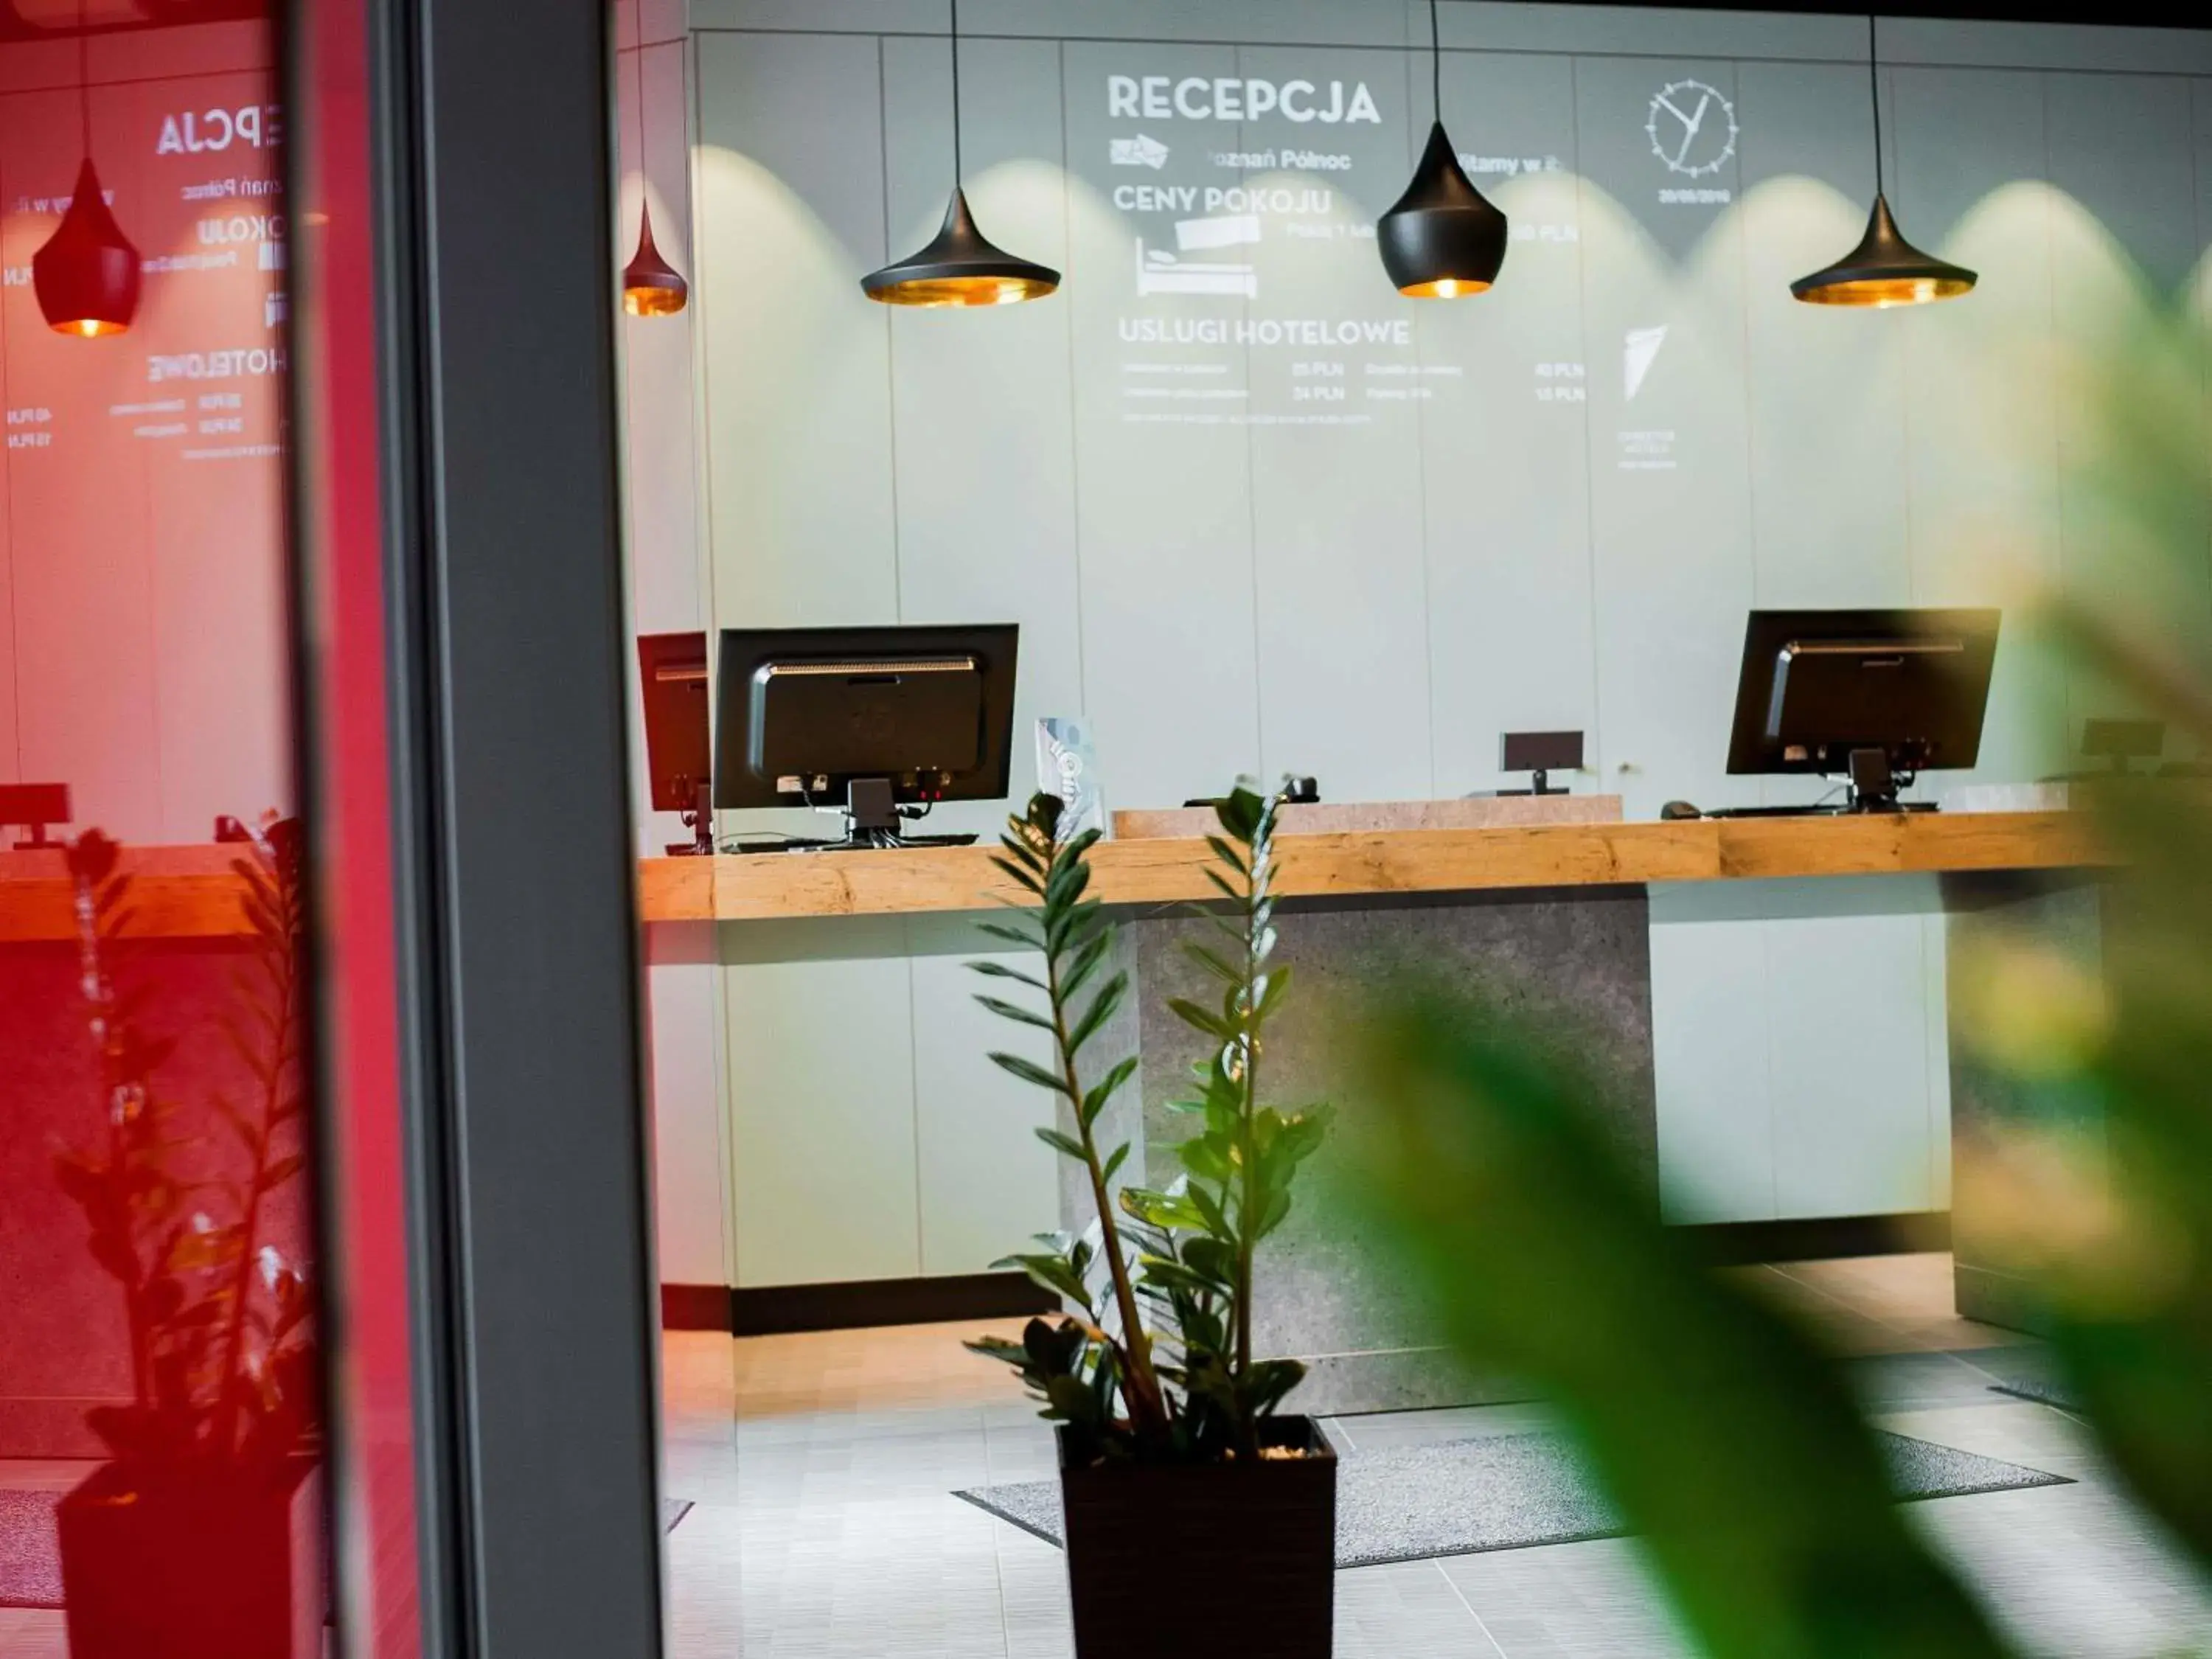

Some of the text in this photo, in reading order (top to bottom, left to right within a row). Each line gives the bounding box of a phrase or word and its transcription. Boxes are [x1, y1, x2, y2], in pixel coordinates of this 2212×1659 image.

[1107, 74, 1382, 124] RECEPCJA
[1113, 184, 1333, 215] CENY POKOJU
[1235, 319, 1410, 345] HOTELOWE
